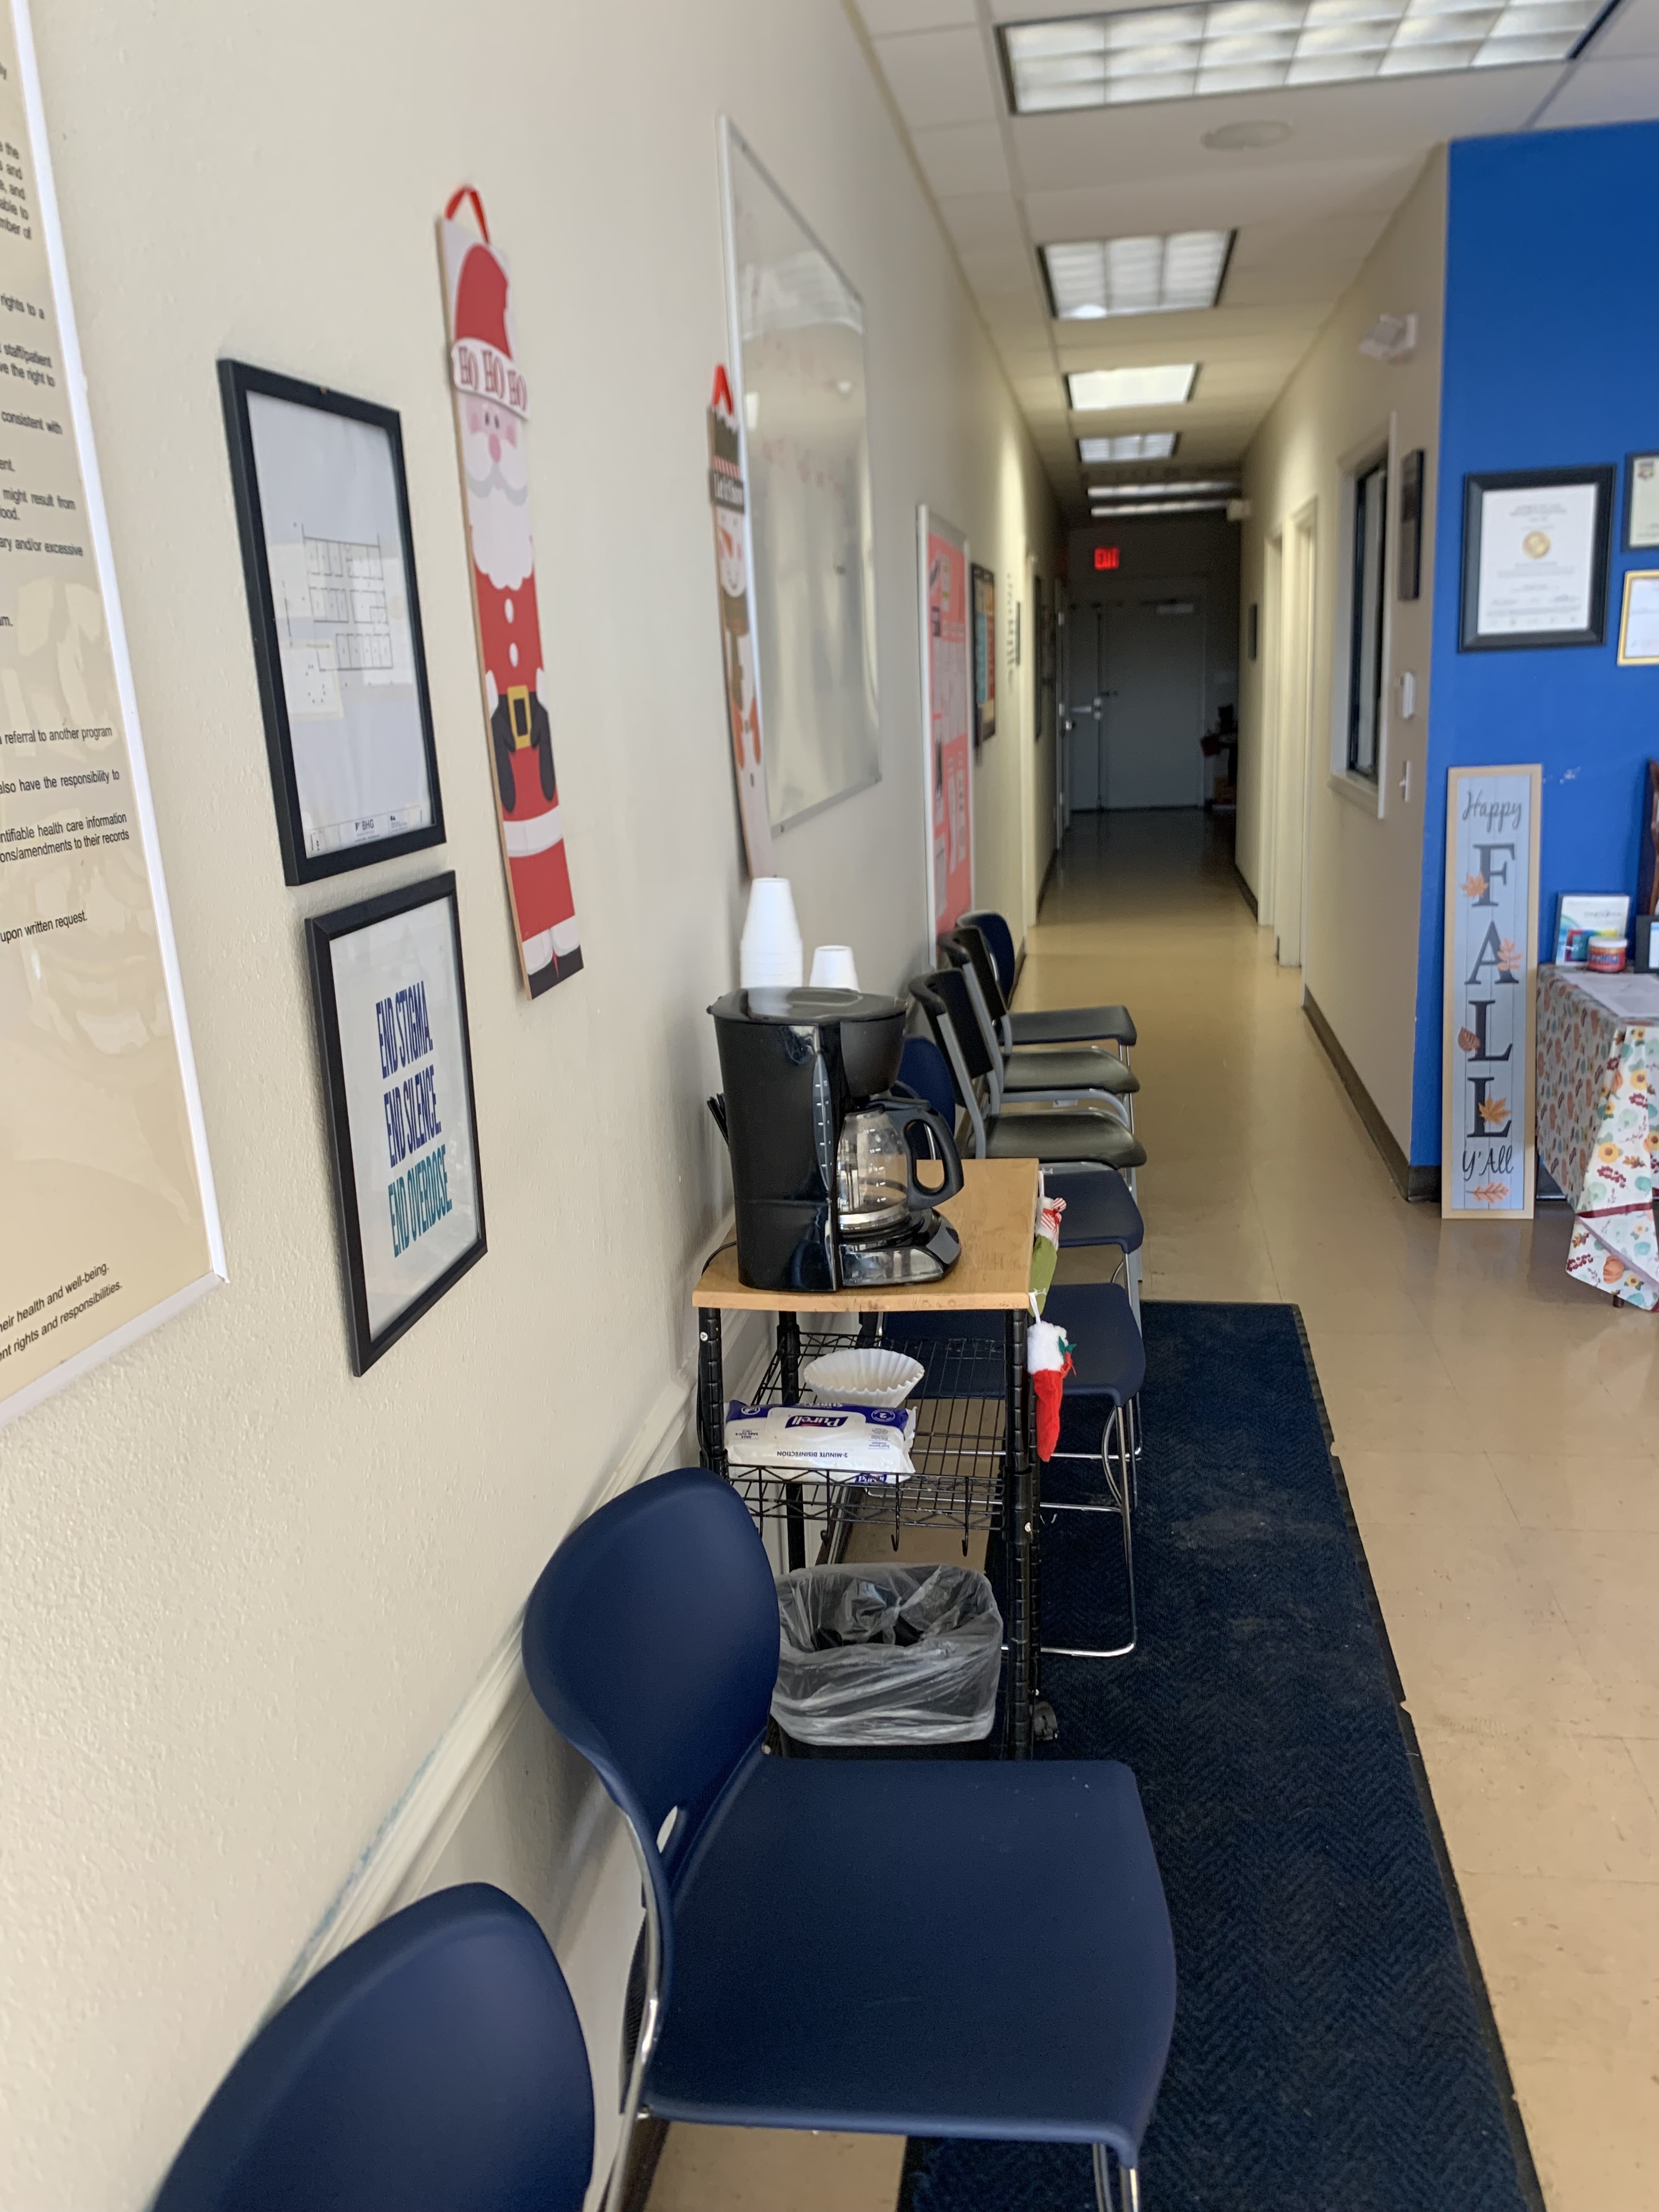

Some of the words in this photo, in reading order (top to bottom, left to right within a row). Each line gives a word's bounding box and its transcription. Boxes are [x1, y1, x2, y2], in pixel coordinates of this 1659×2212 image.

[5, 142, 19, 160] the
[6, 164, 22, 180] and
[9, 184, 25, 200] and
[20, 205, 29, 220] to
[23, 227, 31, 240] of
[1, 294, 25, 312] rights
[27, 302, 36, 316] to
[38, 308, 44, 319] a
[10, 363, 25, 378] the
[27, 368, 46, 385] right
[46, 374, 55, 387] to
[459, 347, 479, 390] HO
[483, 349, 505, 399] HO
[507, 370, 527, 411] HO
[1, 411, 44, 431] consistent
[46, 419, 63, 435] with
[3, 487, 28, 505] might
[30, 494, 54, 507] result
[57, 495, 76, 510] from
[15, 538, 42, 551] and/or
[44, 542, 83, 557] excessive
[1095, 548, 1119, 570] EXIT
[4, 729, 36, 744] referral
[38, 730, 47, 741] to
[49, 727, 79, 741] another
[82, 727, 112, 741] program
[19, 778, 41, 792] have
[43, 776, 57, 788] the
[60, 769, 109, 788] responsibility
[112, 769, 120, 780] to
[1462, 789, 1521, 833] Happy
[0, 826, 35, 843] ntifiable
[37, 822, 63, 837] health
[66, 820, 83, 832] care
[86, 812, 127, 829] information
[362, 819, 374, 831] BHG
[74, 838, 82, 849] to
[83, 833, 100, 848] their
[102, 829, 129, 844] records
[0, 927, 22, 944] upon
[24, 920, 53, 936] written
[55, 910, 88, 929] request.
[376, 997, 398, 1080] END
[396, 980, 433, 1068] STIGMA.
[383, 1086, 406, 1168] END
[403, 1064, 442, 1154] SILENCE.
[1463, 1145, 1514, 1182] Y'All
[388, 1176, 410, 1259] END
[407, 1143, 453, 1242] OVERDOSE.
[16, 1298, 45, 1323] health
[47, 1286, 64, 1305] and
[65, 1263, 110, 1294] well-being.
[14, 1329, 40, 1351] rights
[41, 1316, 58, 1335] and
[60, 1282, 123, 1324] responsibilities.
[791, 1415, 839, 1427] Purell
